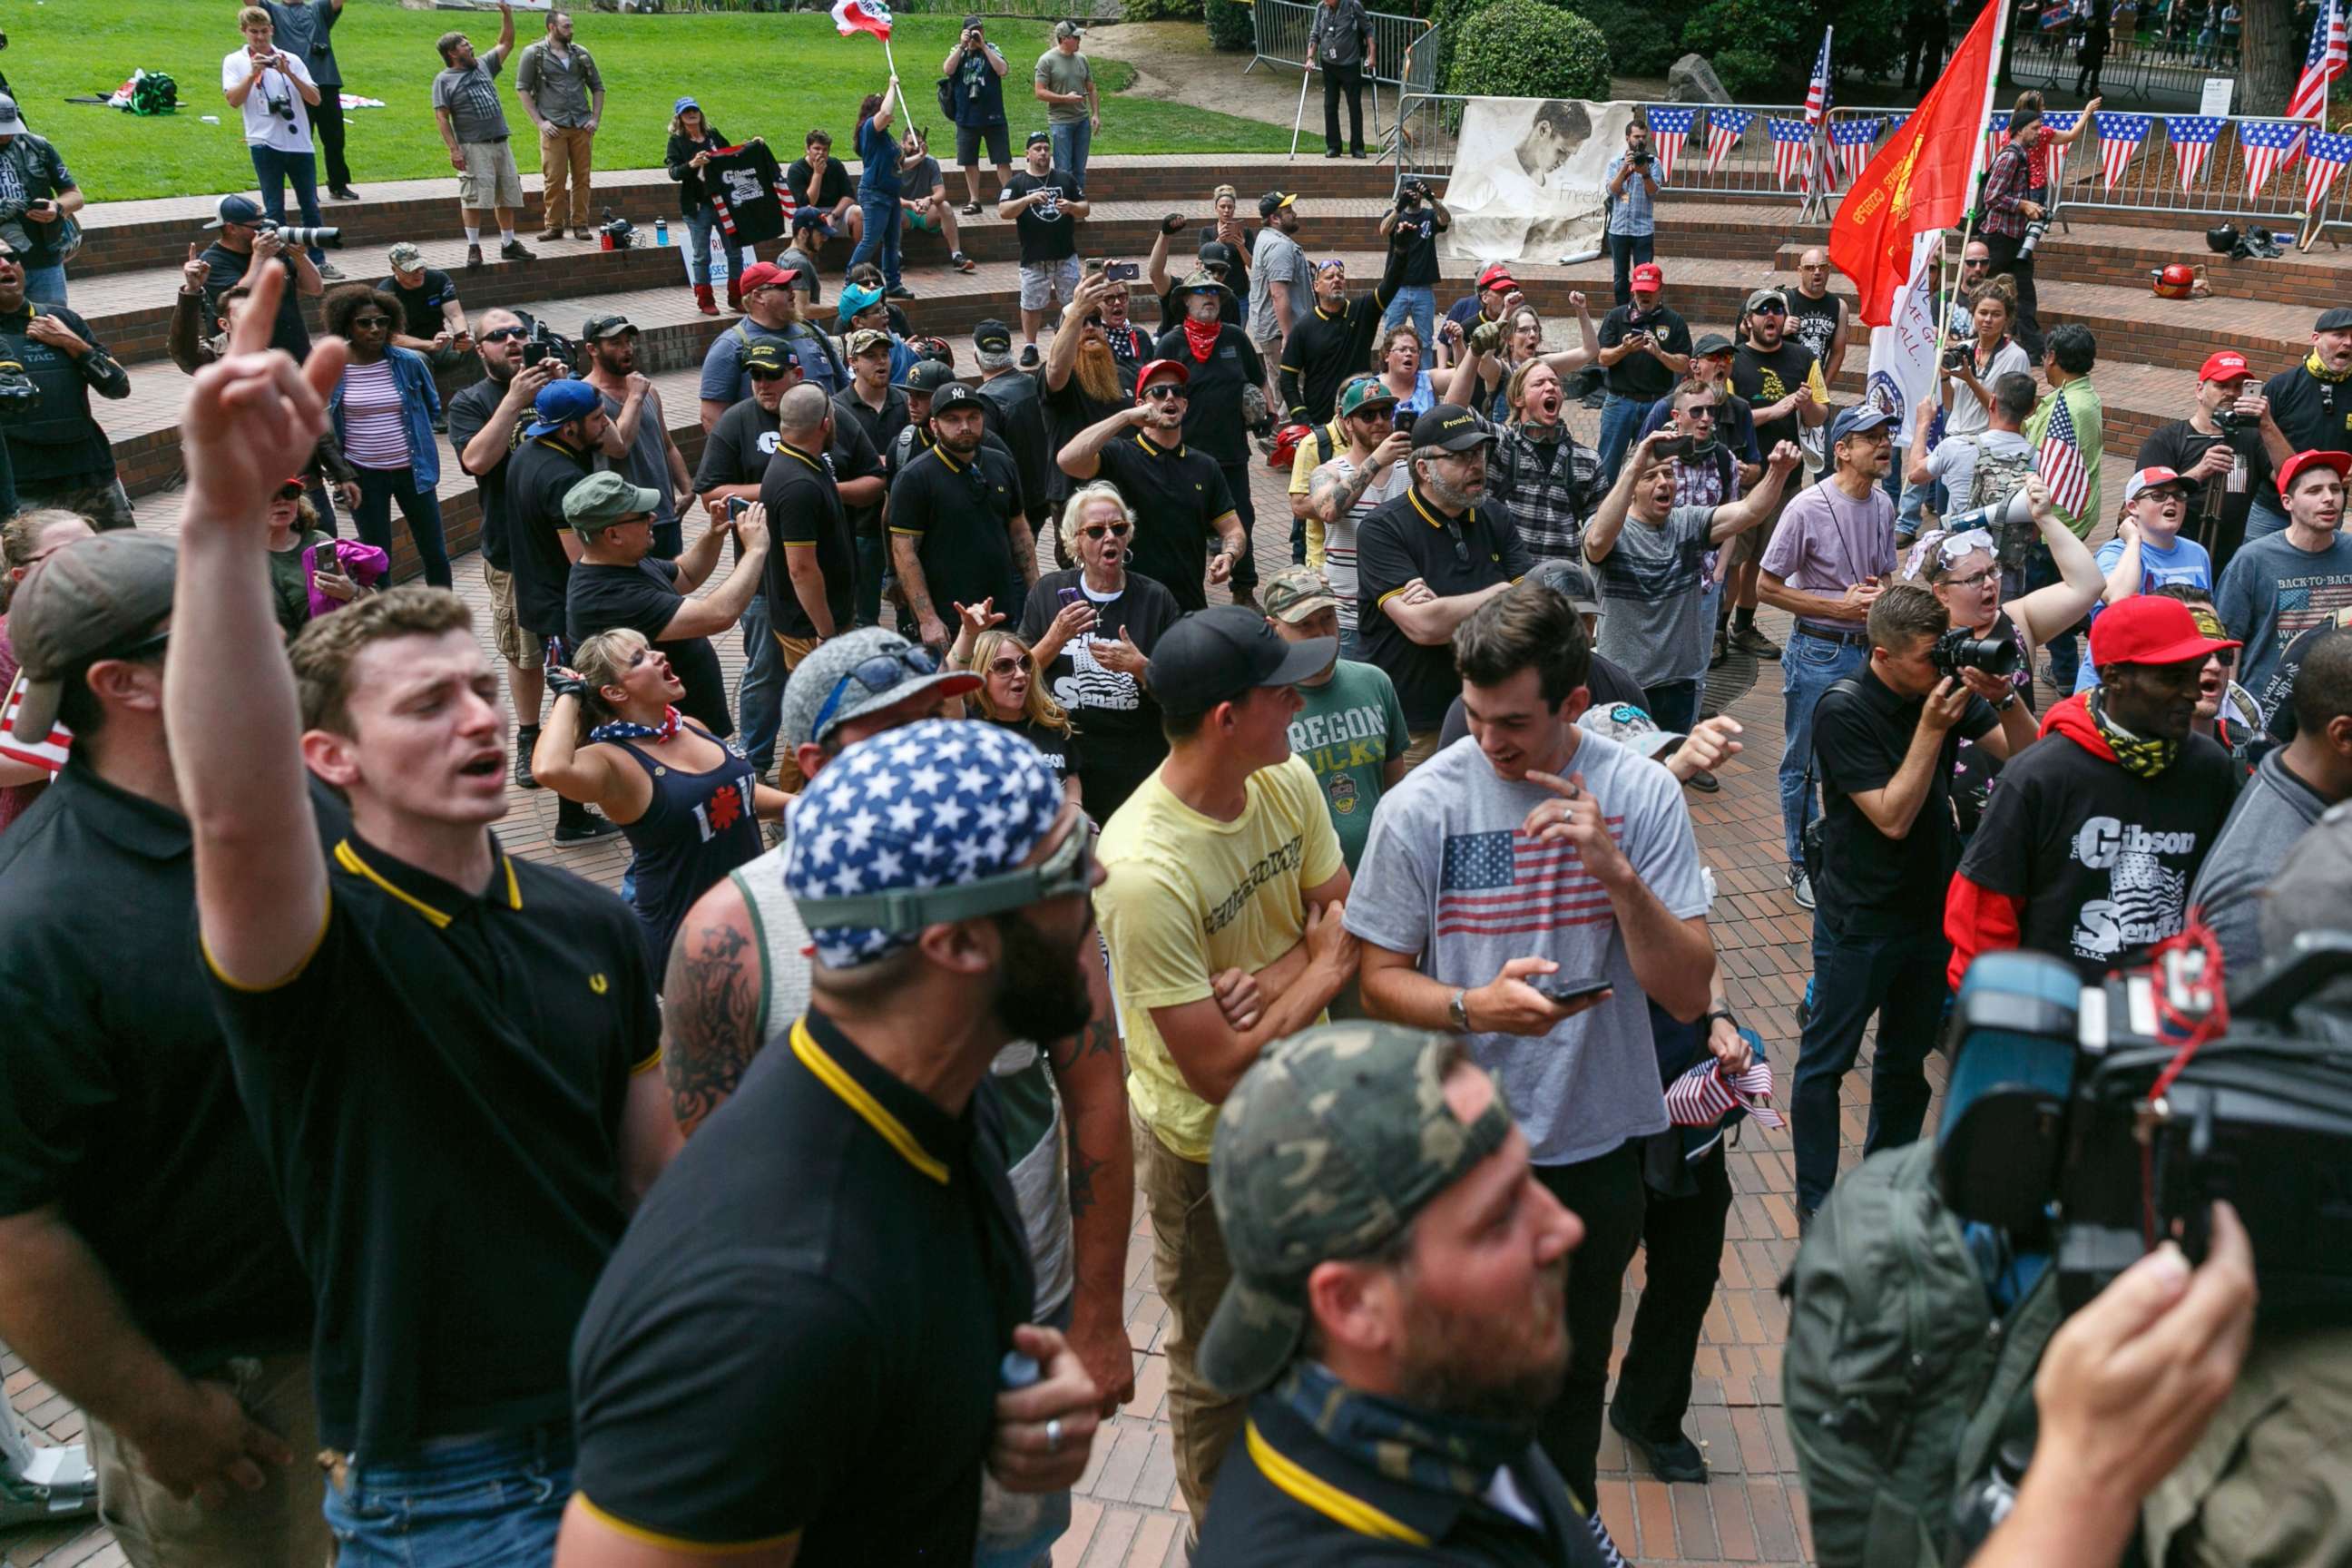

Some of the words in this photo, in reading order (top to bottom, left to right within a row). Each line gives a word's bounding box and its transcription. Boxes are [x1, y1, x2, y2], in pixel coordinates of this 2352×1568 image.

[951, 387, 965, 399] NY
[1442, 415, 1466, 428] Proud
[1054, 676, 1140, 710] Senate
[2079, 816, 2196, 869] Gibson
